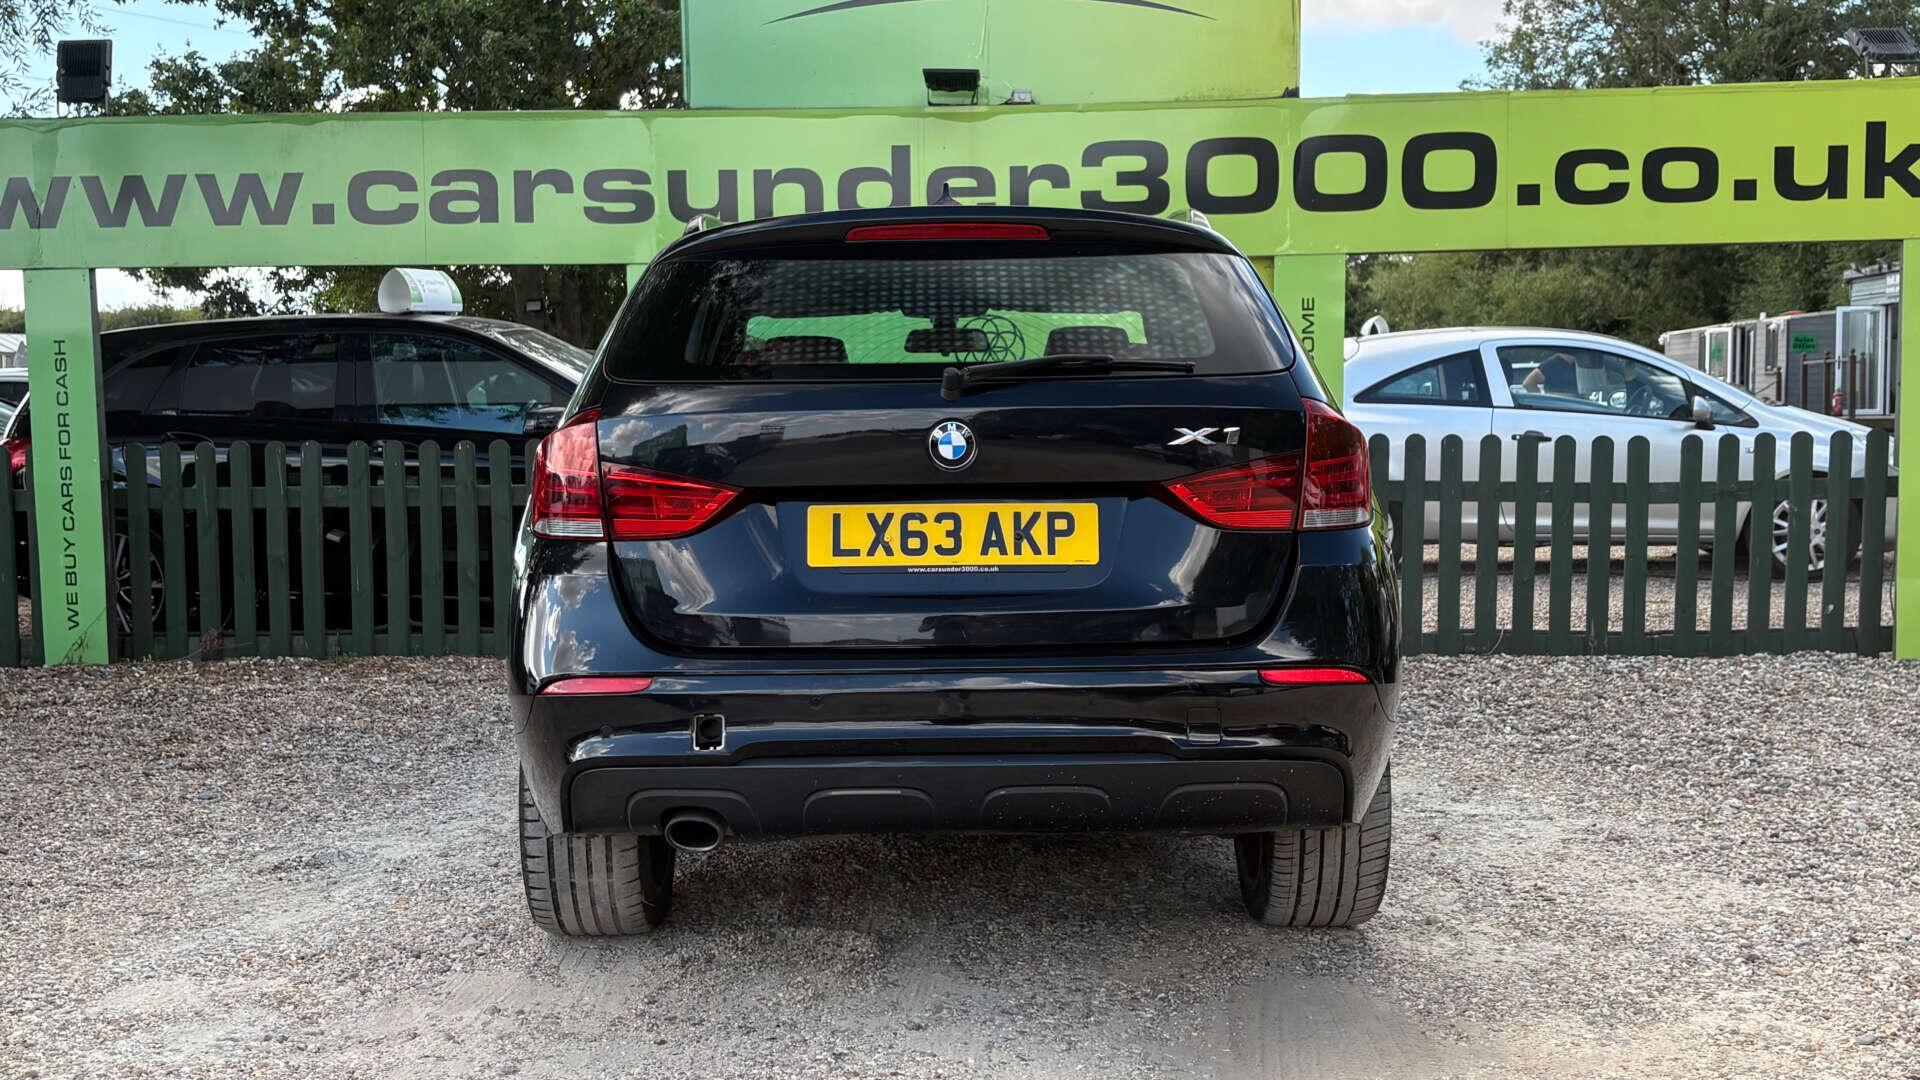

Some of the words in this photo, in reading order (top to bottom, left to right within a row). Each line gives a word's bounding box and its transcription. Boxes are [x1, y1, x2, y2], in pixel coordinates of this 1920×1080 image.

[0, 121, 1920, 229] www.carsunder3000.co.uk
[1302, 296, 1315, 360] OME
[53, 339, 69, 406] CASH
[57, 412, 72, 460] FOR
[1167, 426, 1241, 445] X1
[60, 466, 75, 531] CARS
[832, 511, 963, 557] LX63
[980, 511, 1076, 556] AKP
[63, 537, 78, 586] BUY
[907, 566, 1000, 574] www.carsunder3000.co.uk
[66, 591, 80, 631] WE
